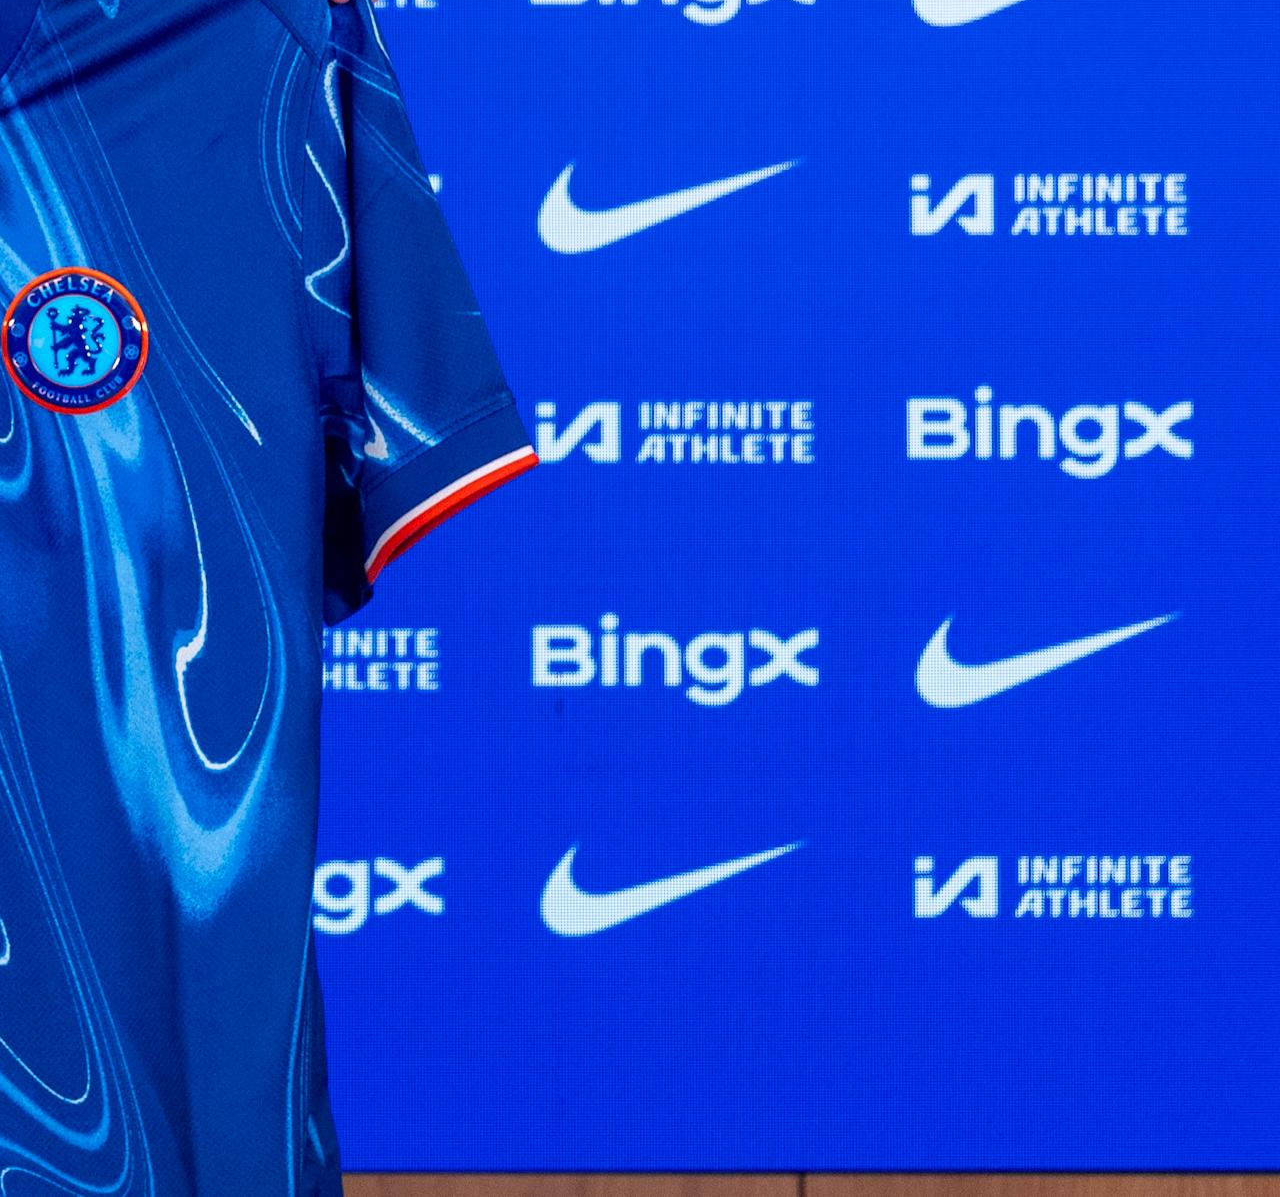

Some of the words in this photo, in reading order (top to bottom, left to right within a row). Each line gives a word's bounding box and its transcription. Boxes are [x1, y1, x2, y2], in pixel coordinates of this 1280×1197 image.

[1015, 175, 1187, 203] INFINITE
[1013, 209, 1188, 236] ATHLETE
[27, 276, 115, 308] CHELSEA
[31, 381, 92, 404] FOOTBALL
[96, 375, 124, 399] CLUB
[642, 403, 812, 430] INFINITE
[639, 436, 813, 464] ATHLETE
[323, 628, 438, 658] INITE
[323, 662, 439, 691] HLETE
[1019, 857, 1190, 884] INFINITE
[1016, 891, 1192, 918] ATHLETE
